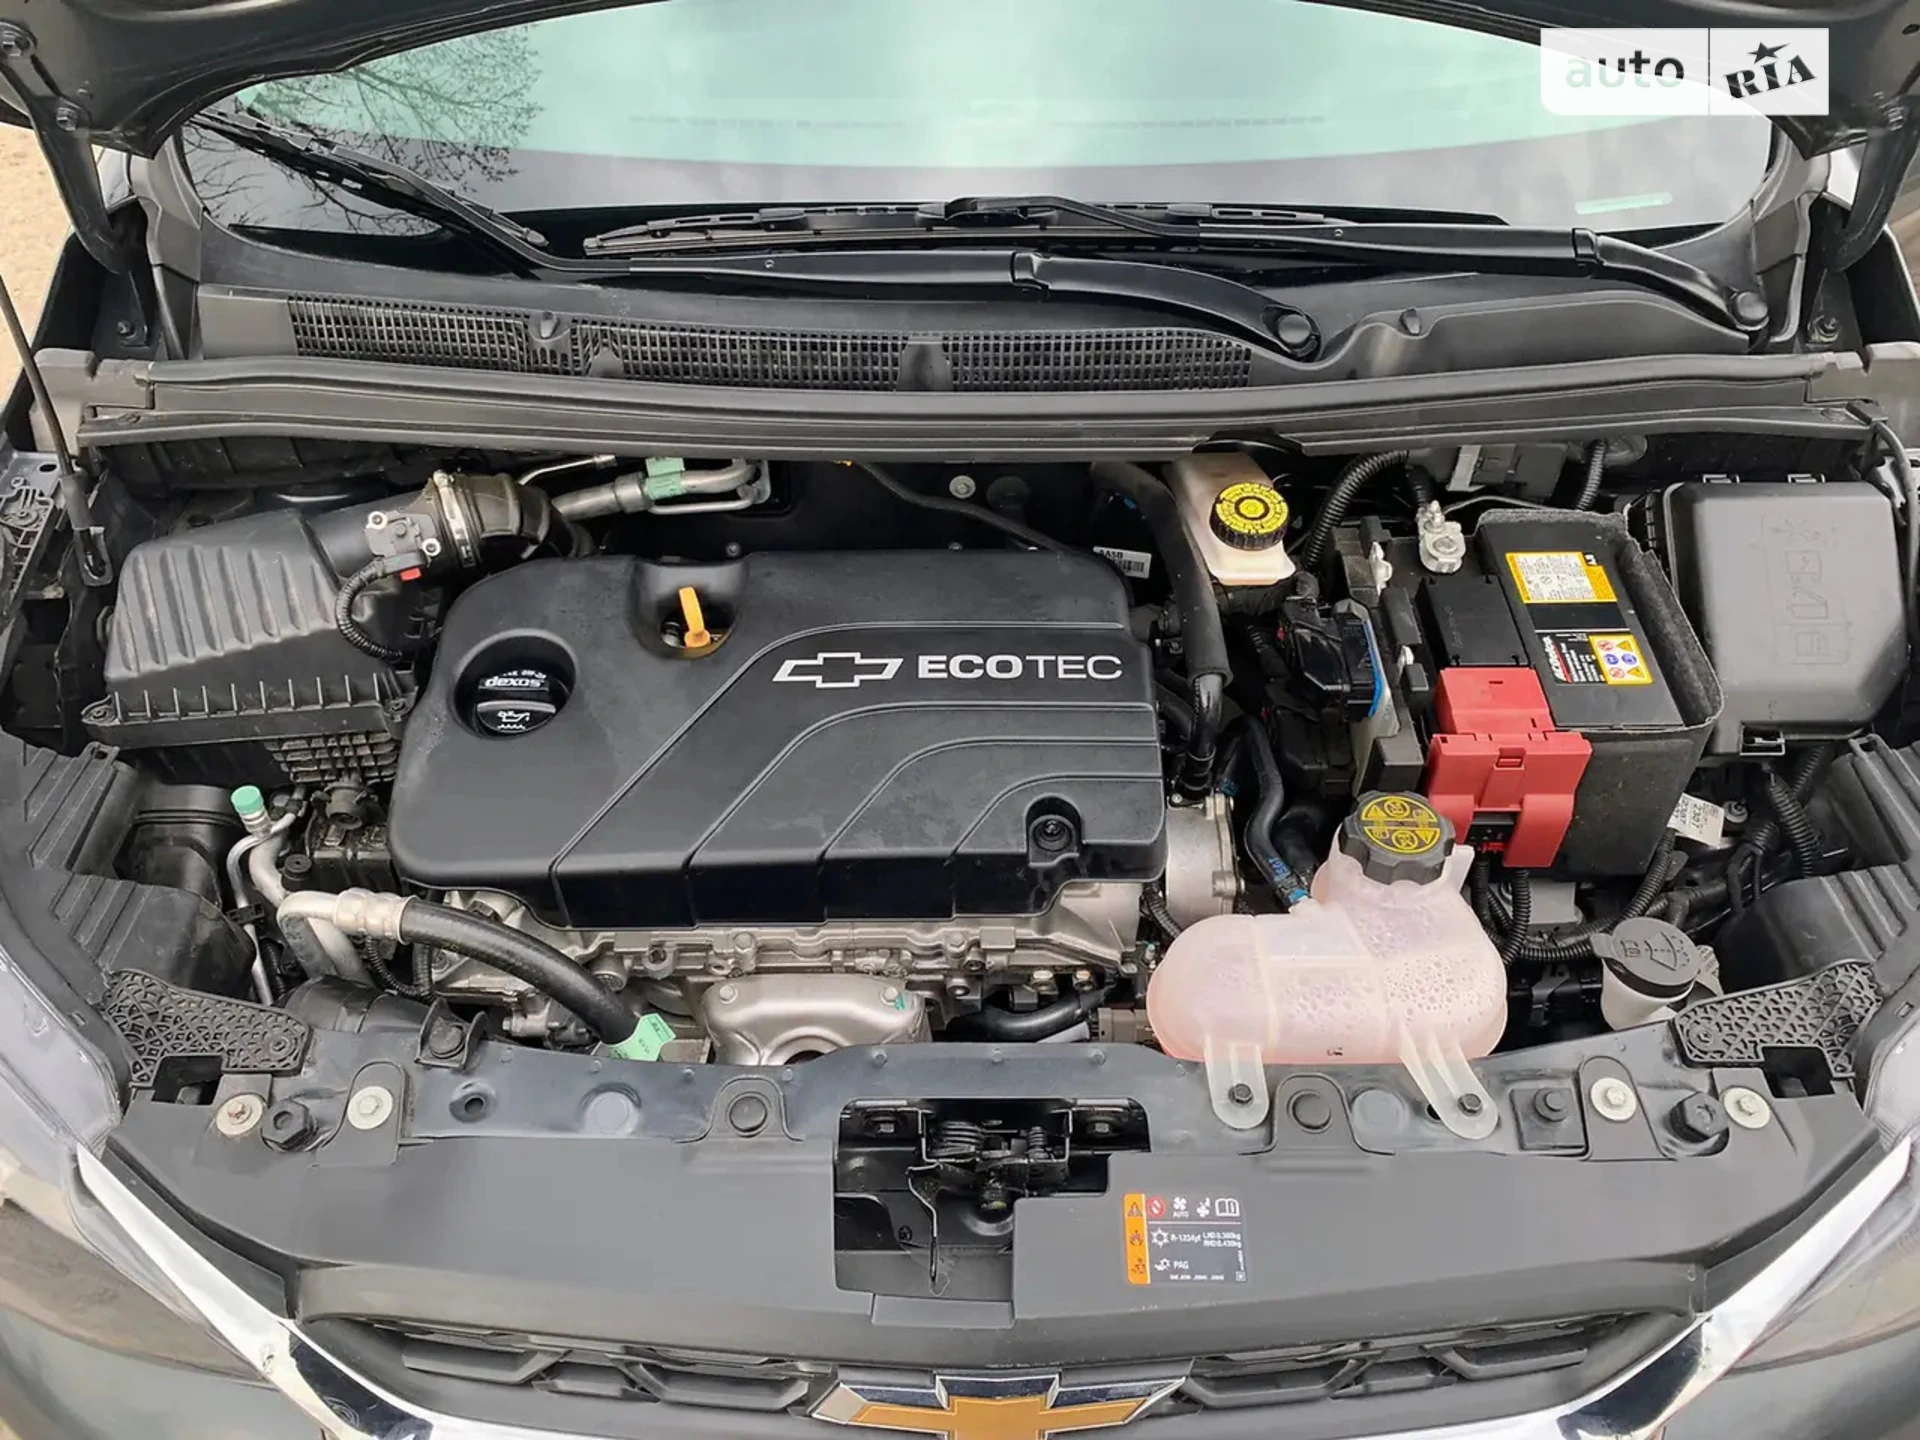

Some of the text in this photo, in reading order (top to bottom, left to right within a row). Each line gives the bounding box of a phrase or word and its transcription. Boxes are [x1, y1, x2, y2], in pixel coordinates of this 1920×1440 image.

[918, 655, 1123, 679] ECOTEC
[485, 676, 541, 688] dexos
[1173, 1260, 1189, 1269] PAG
